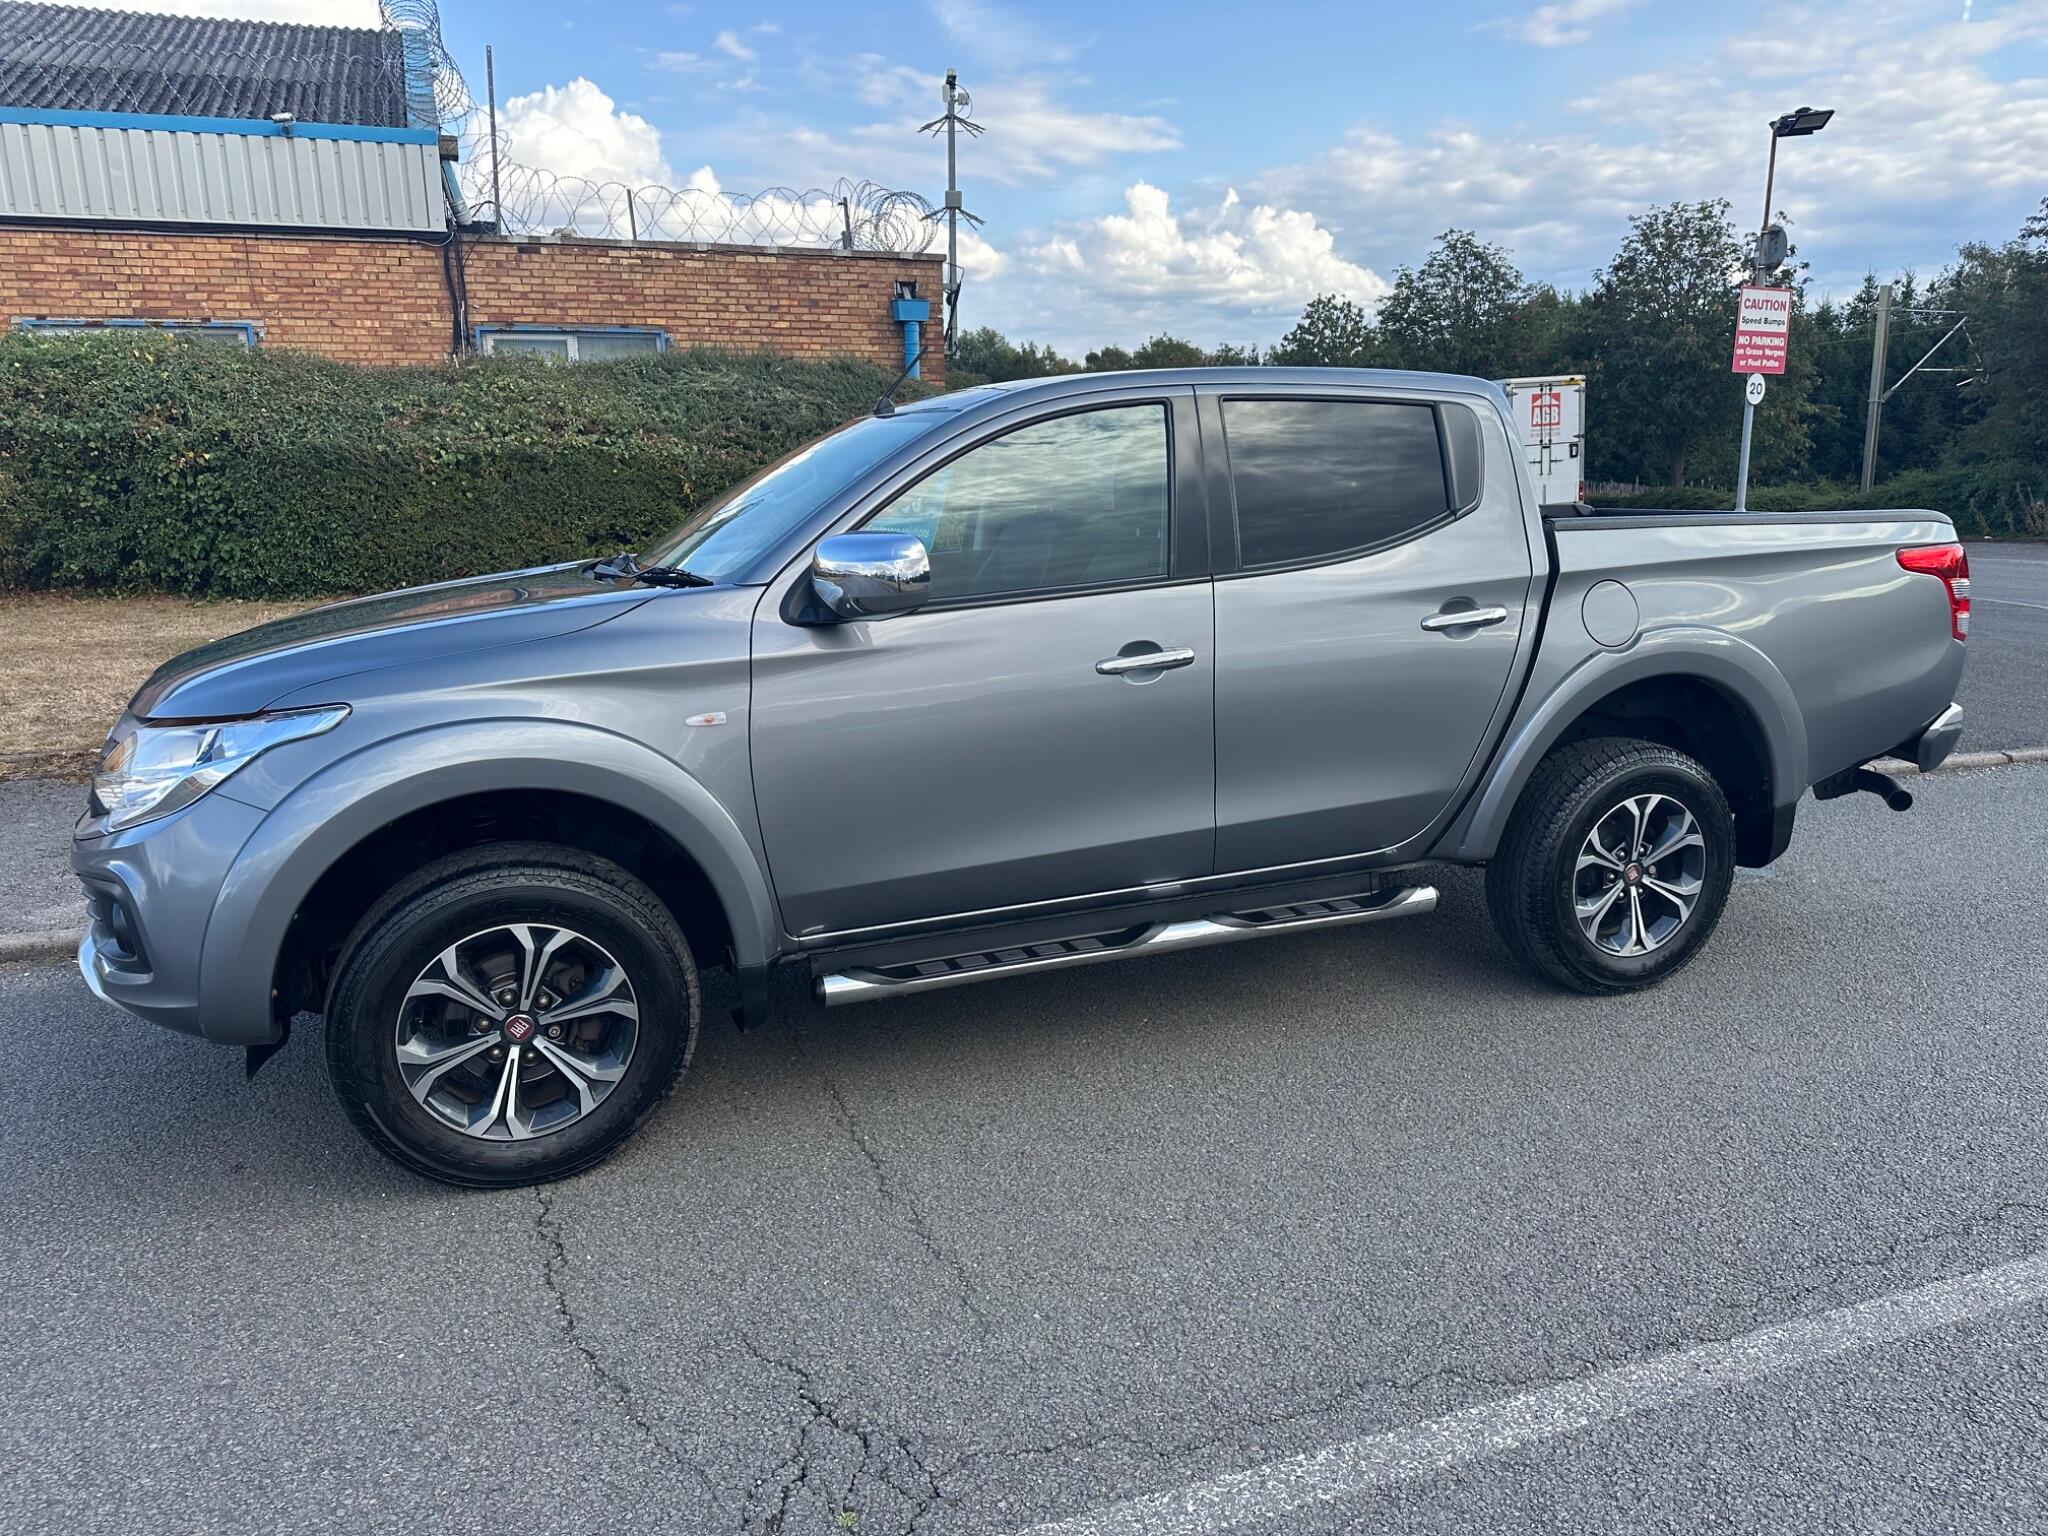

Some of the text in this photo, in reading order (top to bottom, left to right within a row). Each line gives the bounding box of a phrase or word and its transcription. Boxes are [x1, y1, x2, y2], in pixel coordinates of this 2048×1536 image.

[1744, 298, 1787, 312] CAUTION
[1741, 316, 1785, 326] Speed Bumps
[1738, 335, 1784, 346] NO PARKING
[1736, 347, 1784, 357] on Grass Verges
[1747, 358, 1761, 367] Foot
[1762, 359, 1779, 368] Paths
[1749, 382, 1763, 395] 20
[1533, 406, 1559, 425] AGB
[509, 1019, 529, 1038] FIAT
